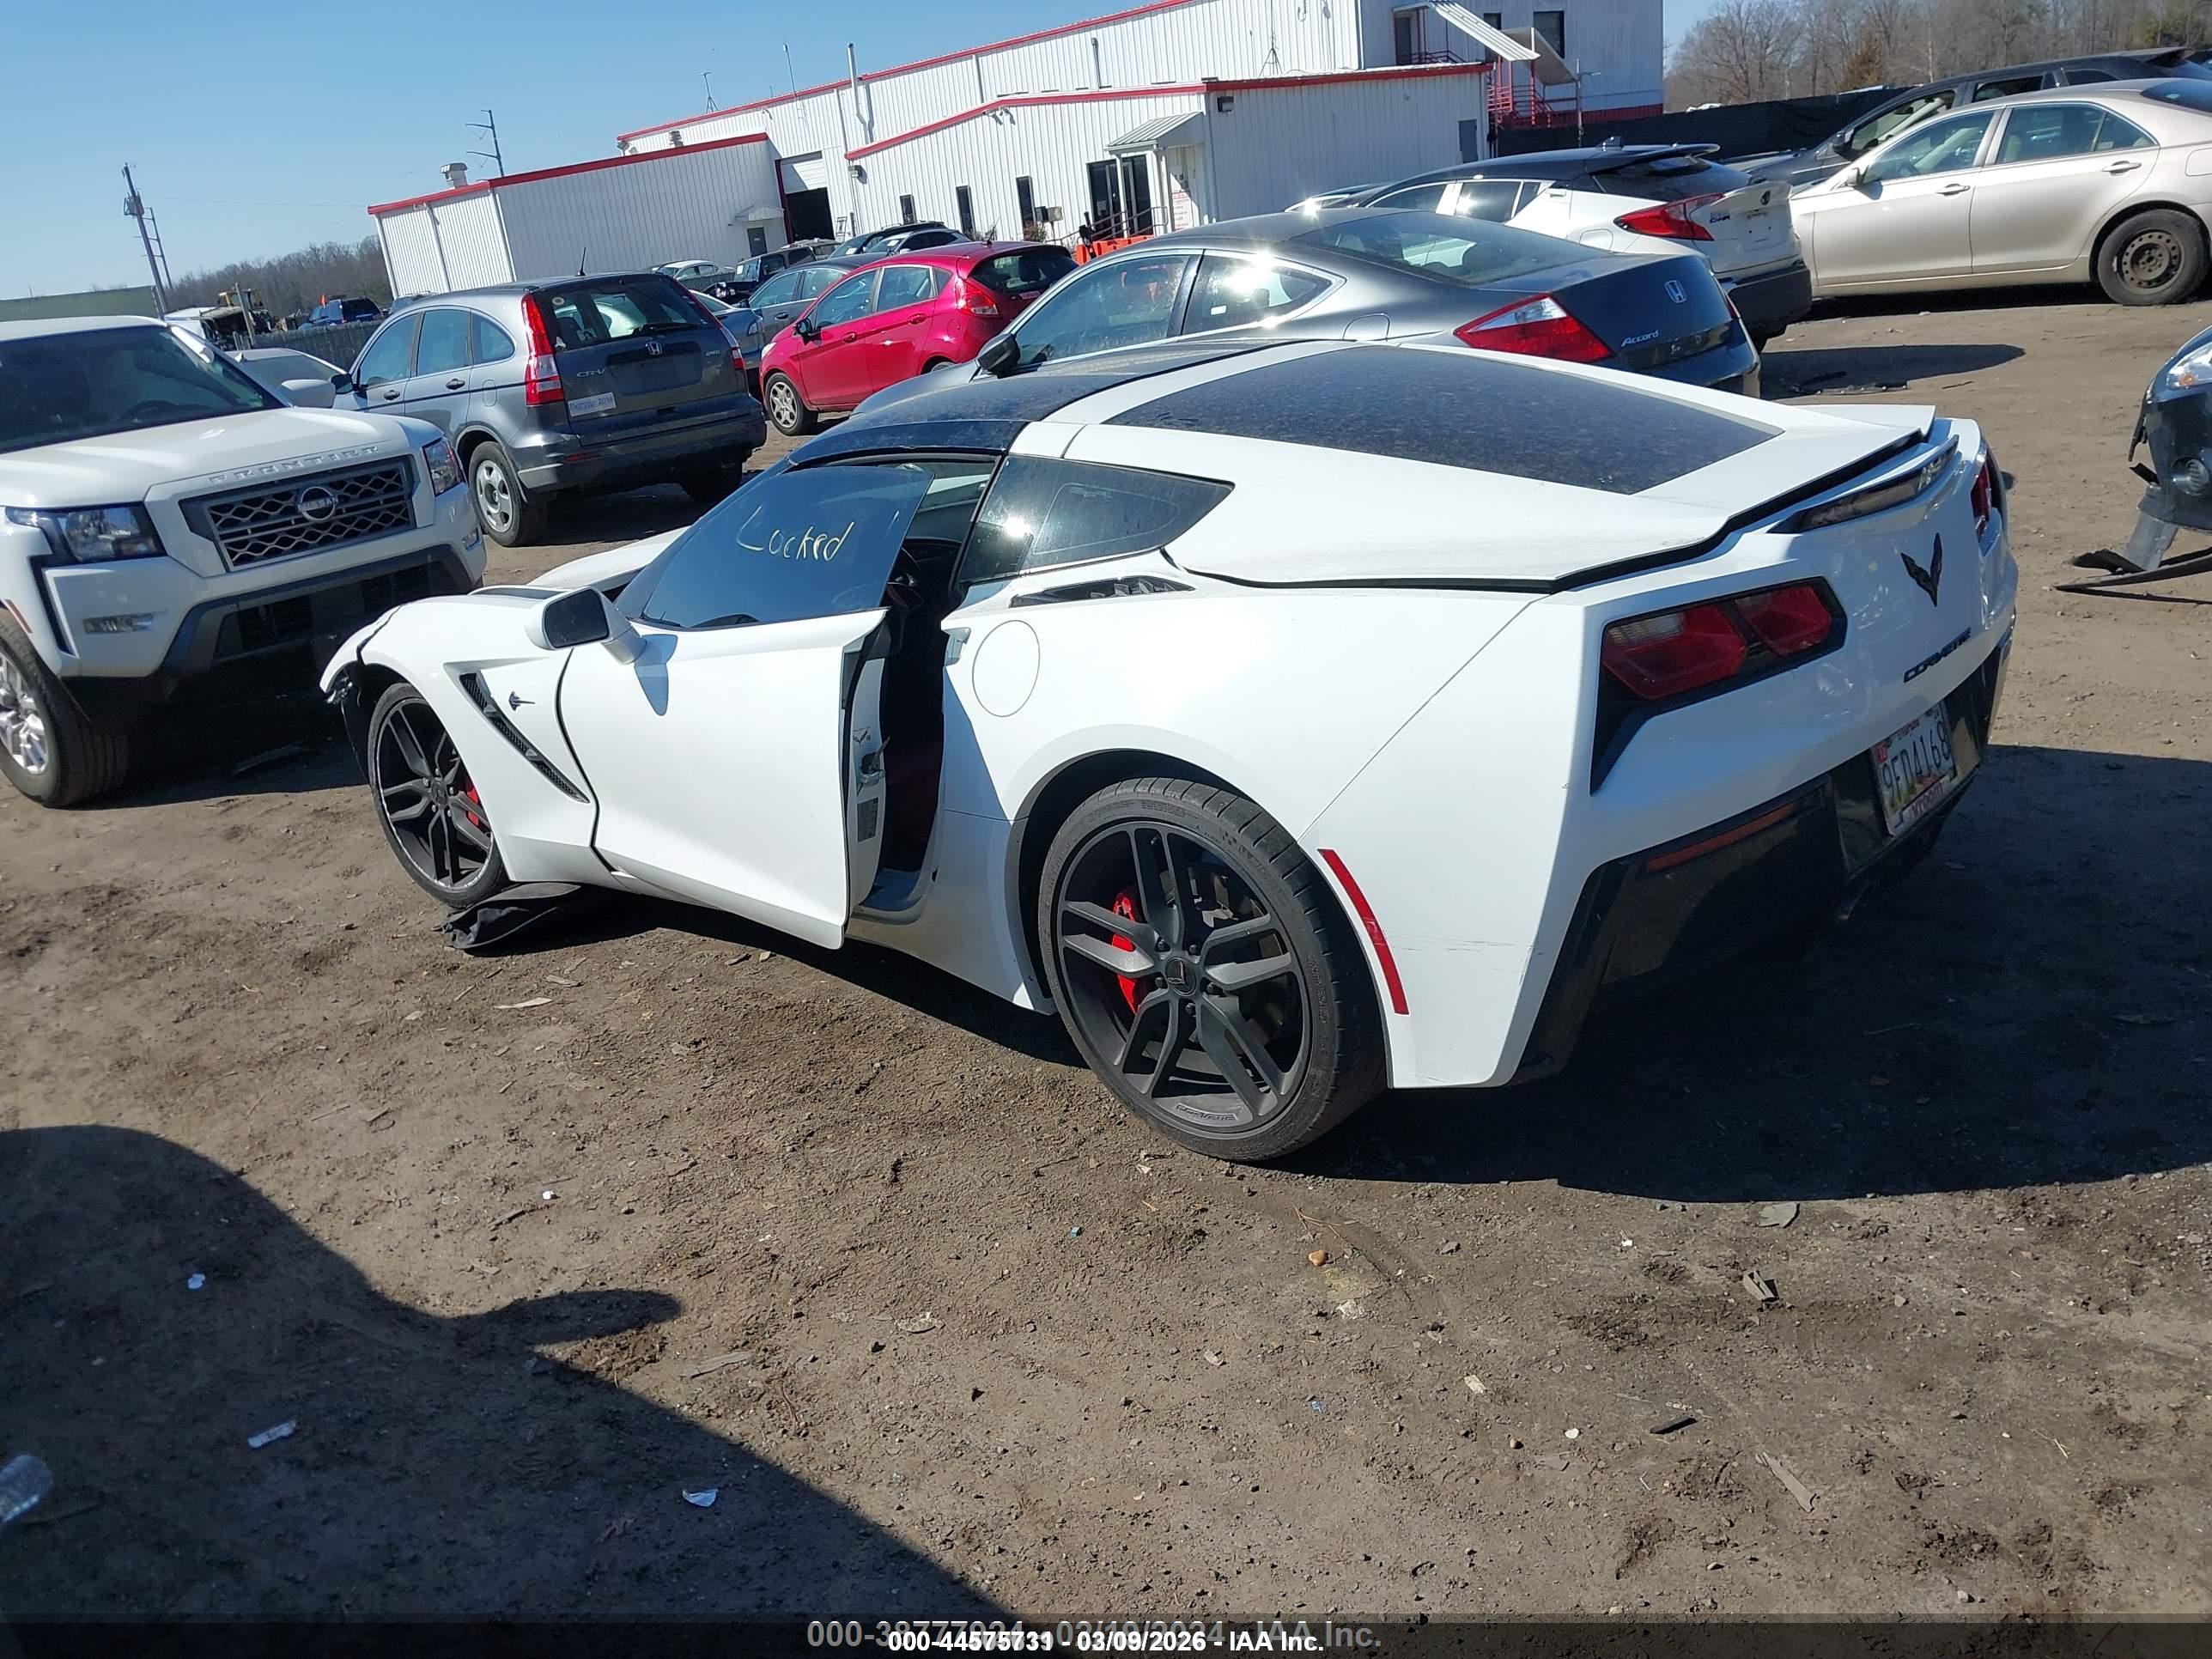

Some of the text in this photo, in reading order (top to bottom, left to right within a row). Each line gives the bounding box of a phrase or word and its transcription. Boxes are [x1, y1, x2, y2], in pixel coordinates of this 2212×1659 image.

[1621, 330, 1659, 347] Accord
[576, 368, 606, 378] CR-V
[209, 446, 379, 483] FRONTIER
[736, 505, 854, 562] Locked
[1881, 720, 1951, 808] 9FD4168
